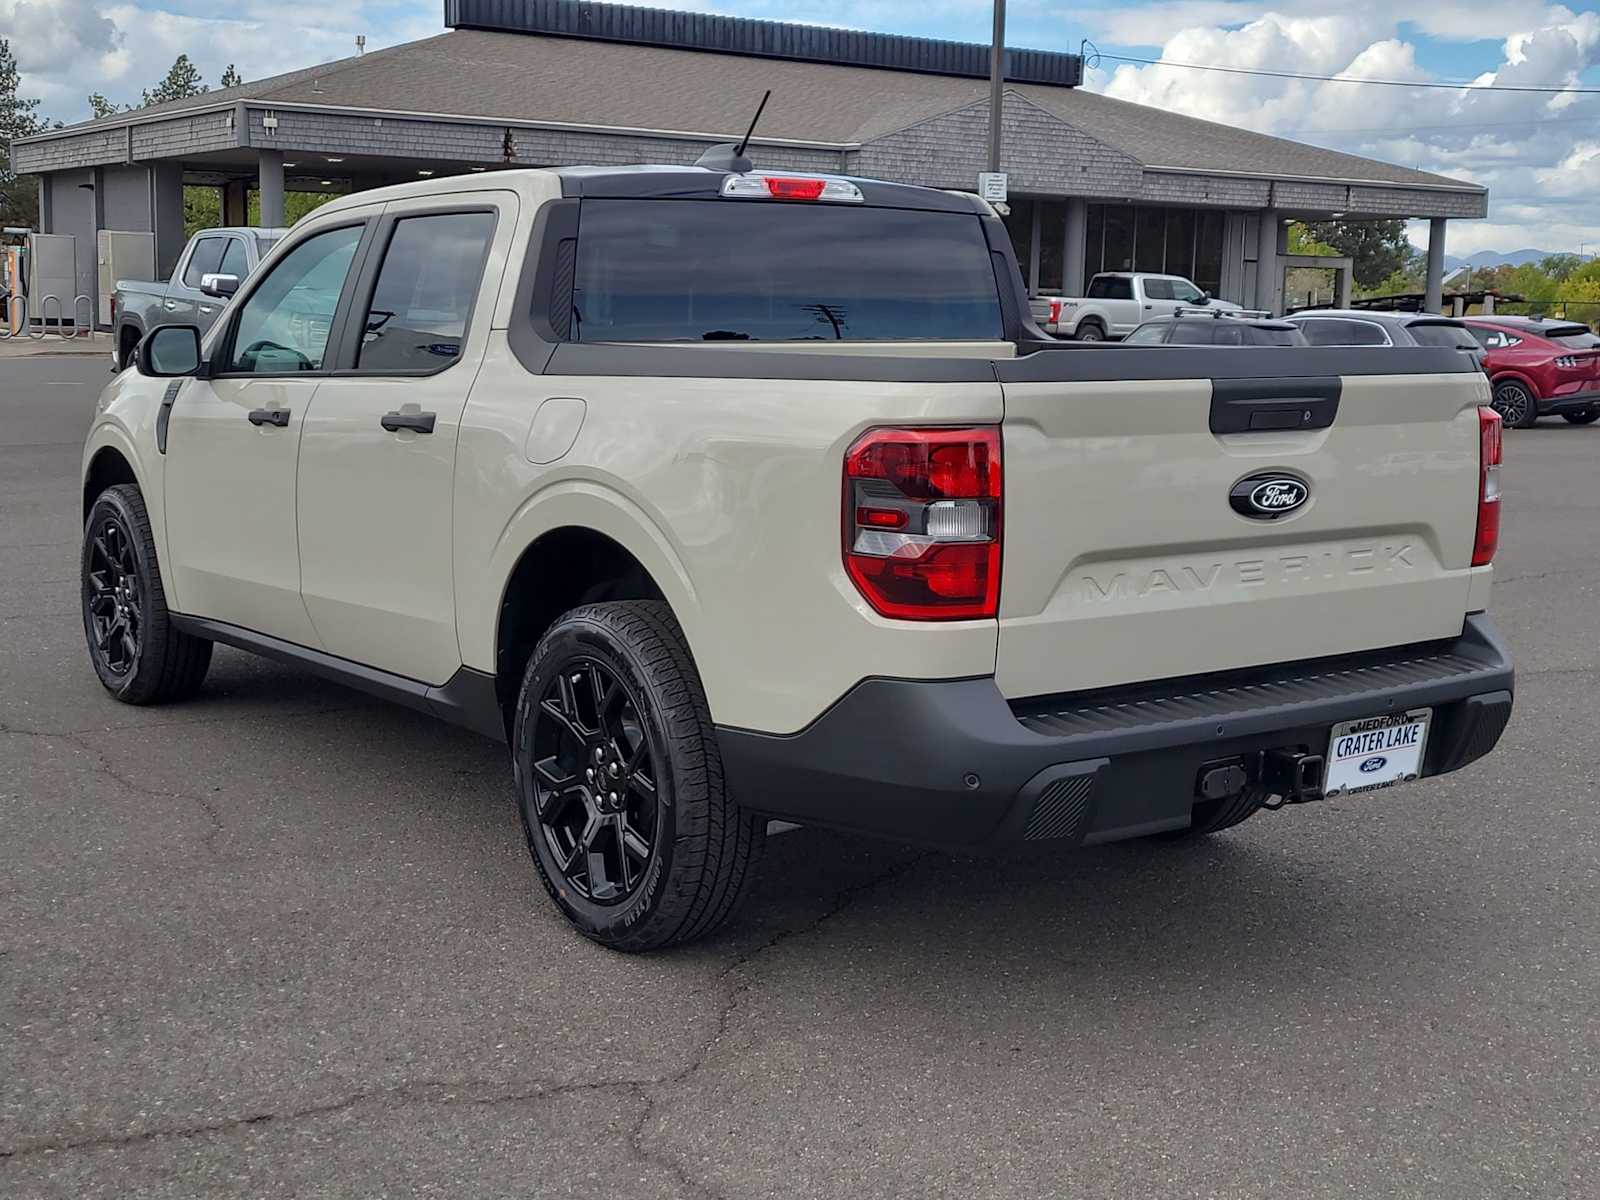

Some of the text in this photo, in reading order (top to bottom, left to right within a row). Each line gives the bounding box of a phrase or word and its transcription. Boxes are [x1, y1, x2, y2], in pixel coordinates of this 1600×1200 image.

[1261, 483, 1297, 506] Ford
[1082, 544, 1414, 601] MAVERICK
[1358, 713, 1409, 731] MEDFORD
[1337, 724, 1419, 758] CRATER LAKE
